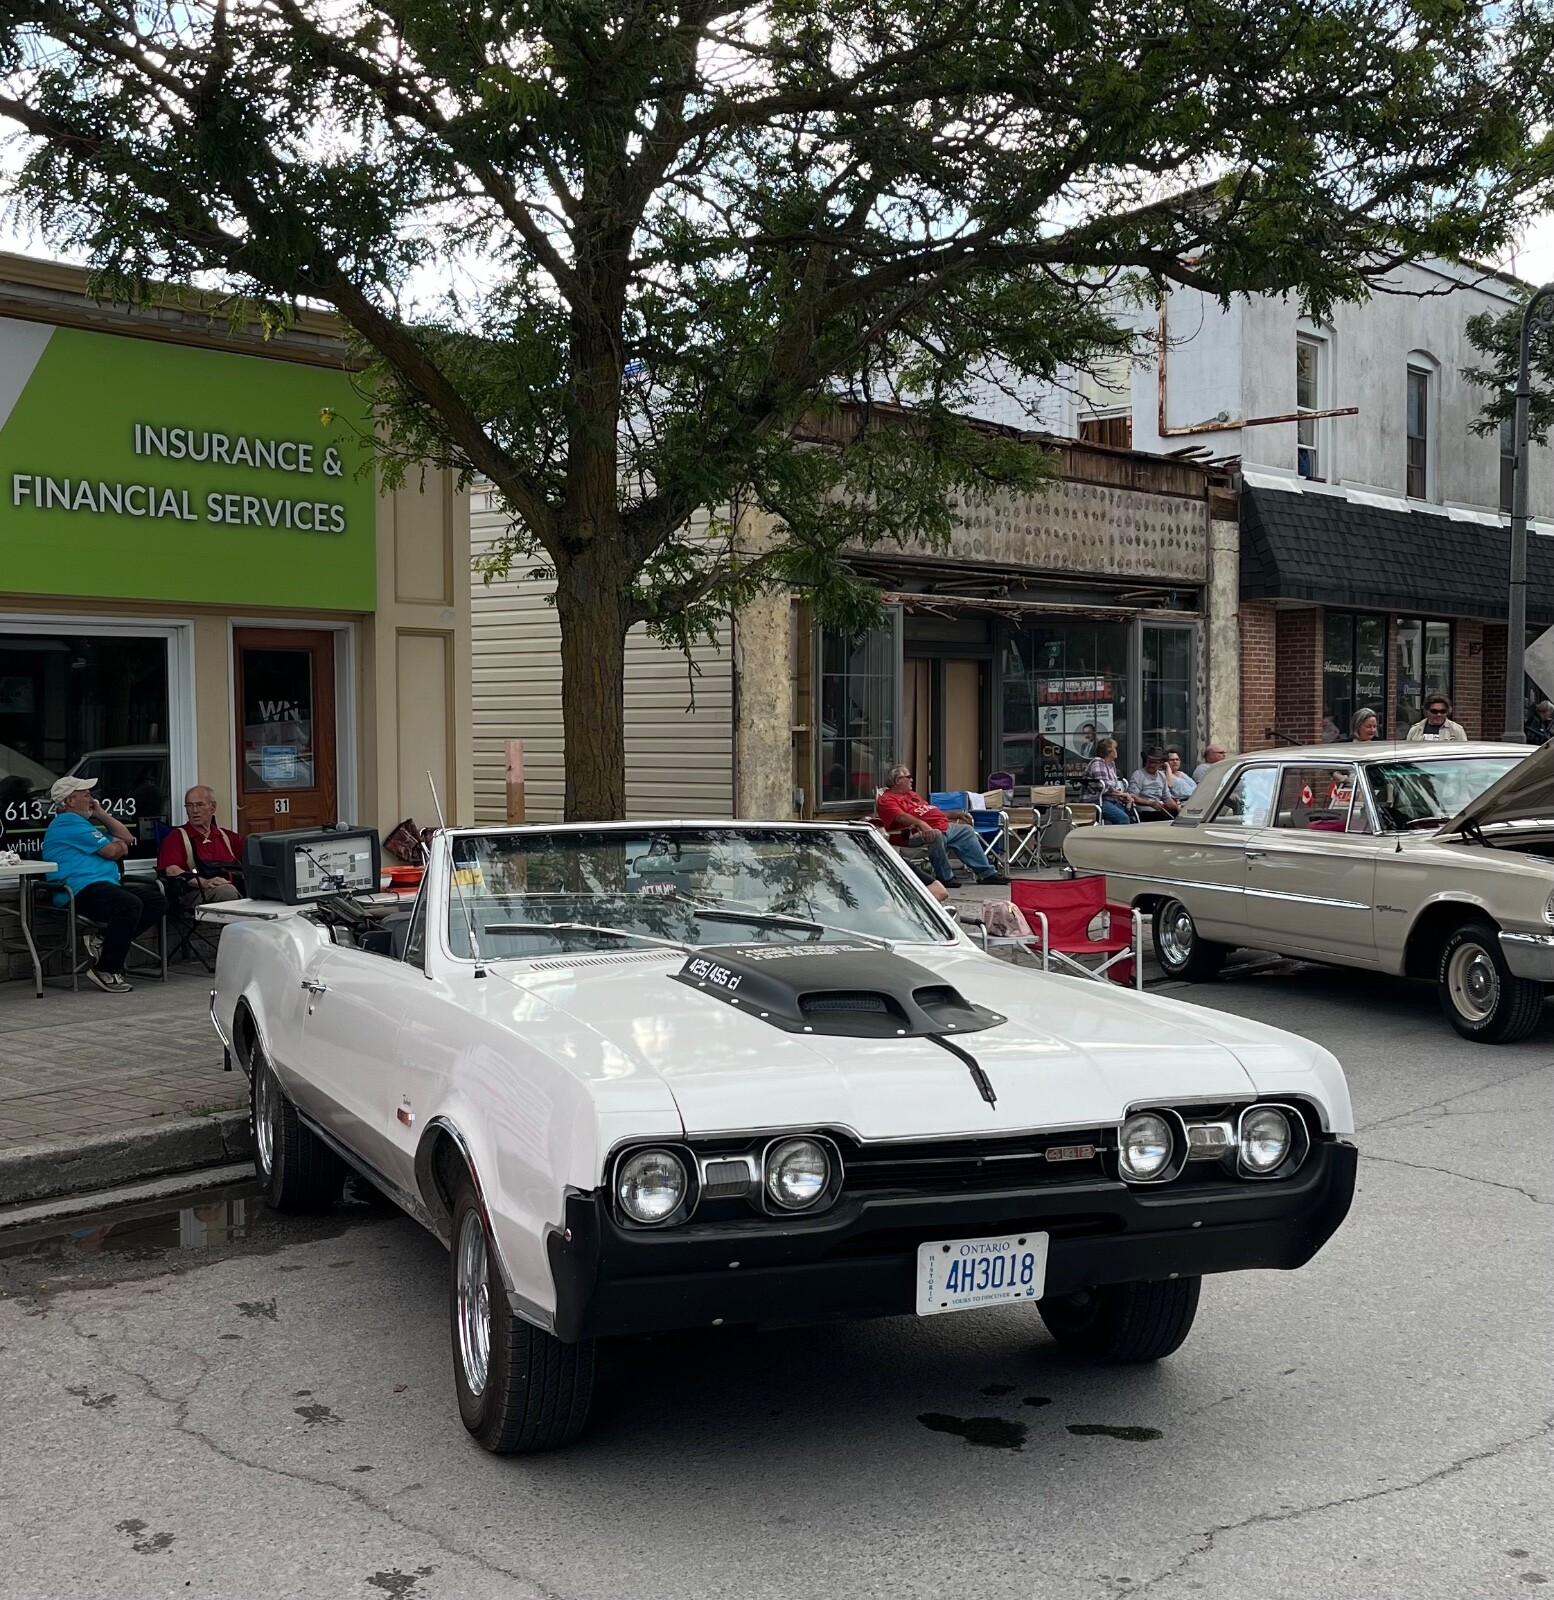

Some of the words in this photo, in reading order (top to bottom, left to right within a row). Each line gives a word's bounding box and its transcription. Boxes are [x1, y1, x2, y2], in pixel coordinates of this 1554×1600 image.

[134, 423, 314, 473] INSURANCE
[322, 447, 344, 477] &
[12, 473, 198, 520] FINANCIAL
[206, 493, 345, 533] SERVICES
[1323, 660, 1353, 676] Homestyle
[275, 800, 288, 813] 31
[688, 958, 732, 985] 425/455
[727, 974, 742, 991] ci
[945, 1252, 1035, 1294] 4H3018
[952, 1297, 972, 1305] YOURS
[981, 1292, 1010, 1301] DISCOVER
